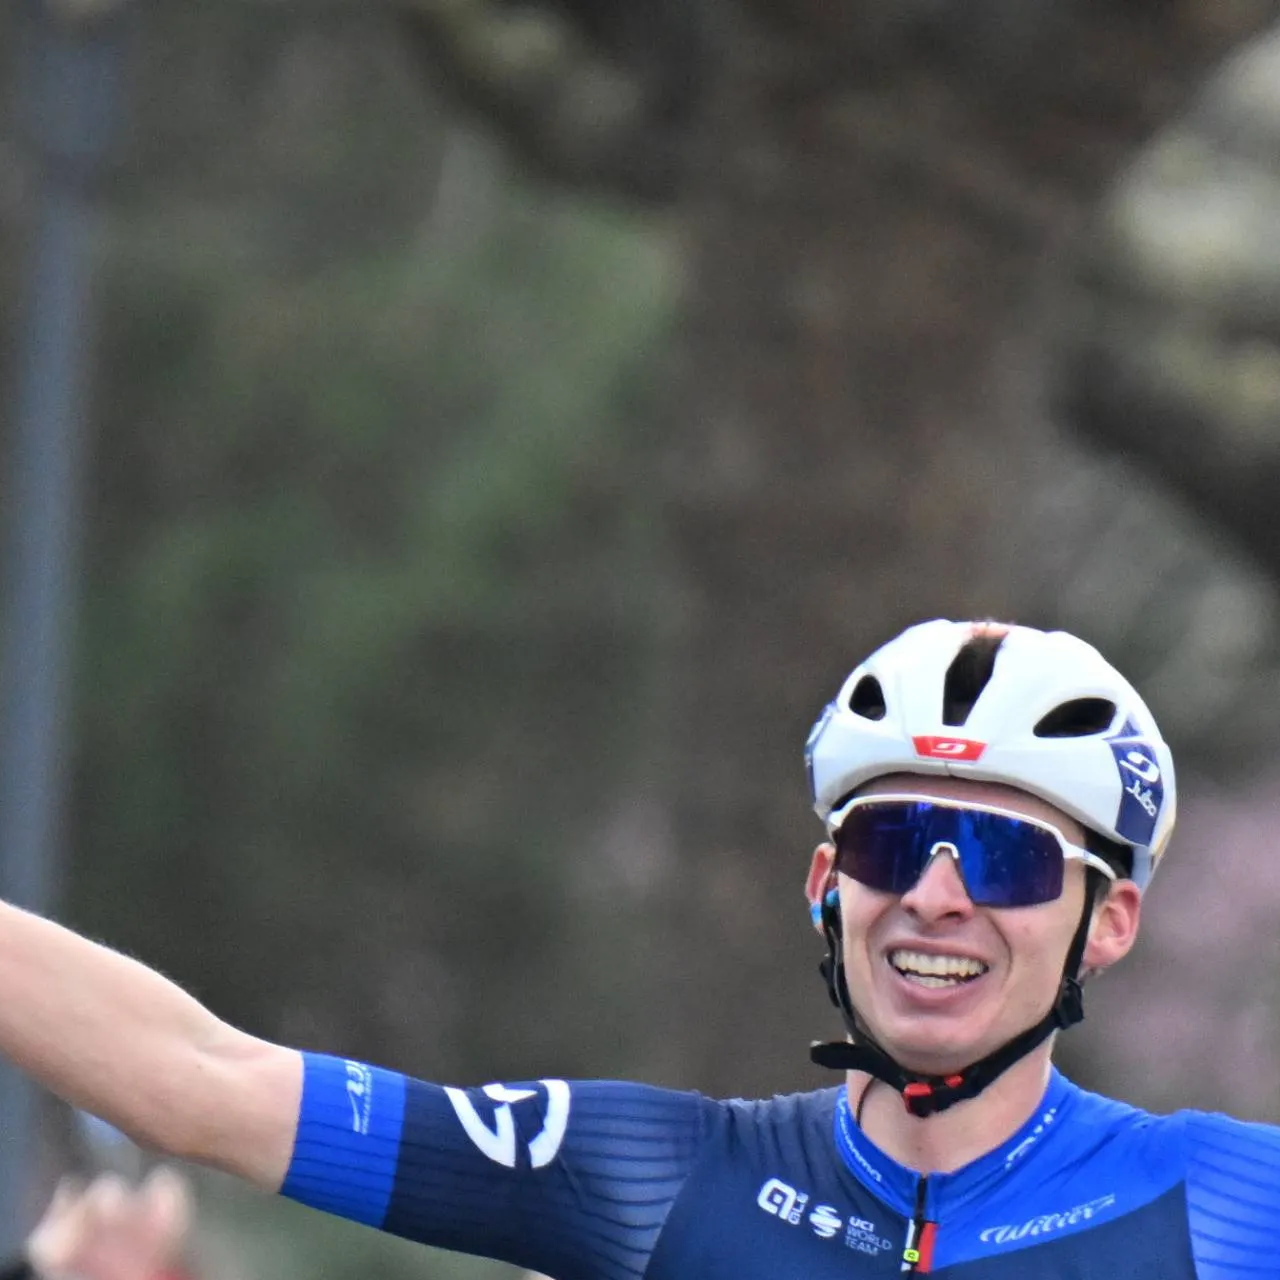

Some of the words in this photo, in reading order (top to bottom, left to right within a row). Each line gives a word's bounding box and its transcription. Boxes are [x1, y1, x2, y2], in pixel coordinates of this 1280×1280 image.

[848, 1215, 875, 1233] UCI
[844, 1235, 879, 1257] TEAM
[846, 1225, 893, 1251] WORLD
